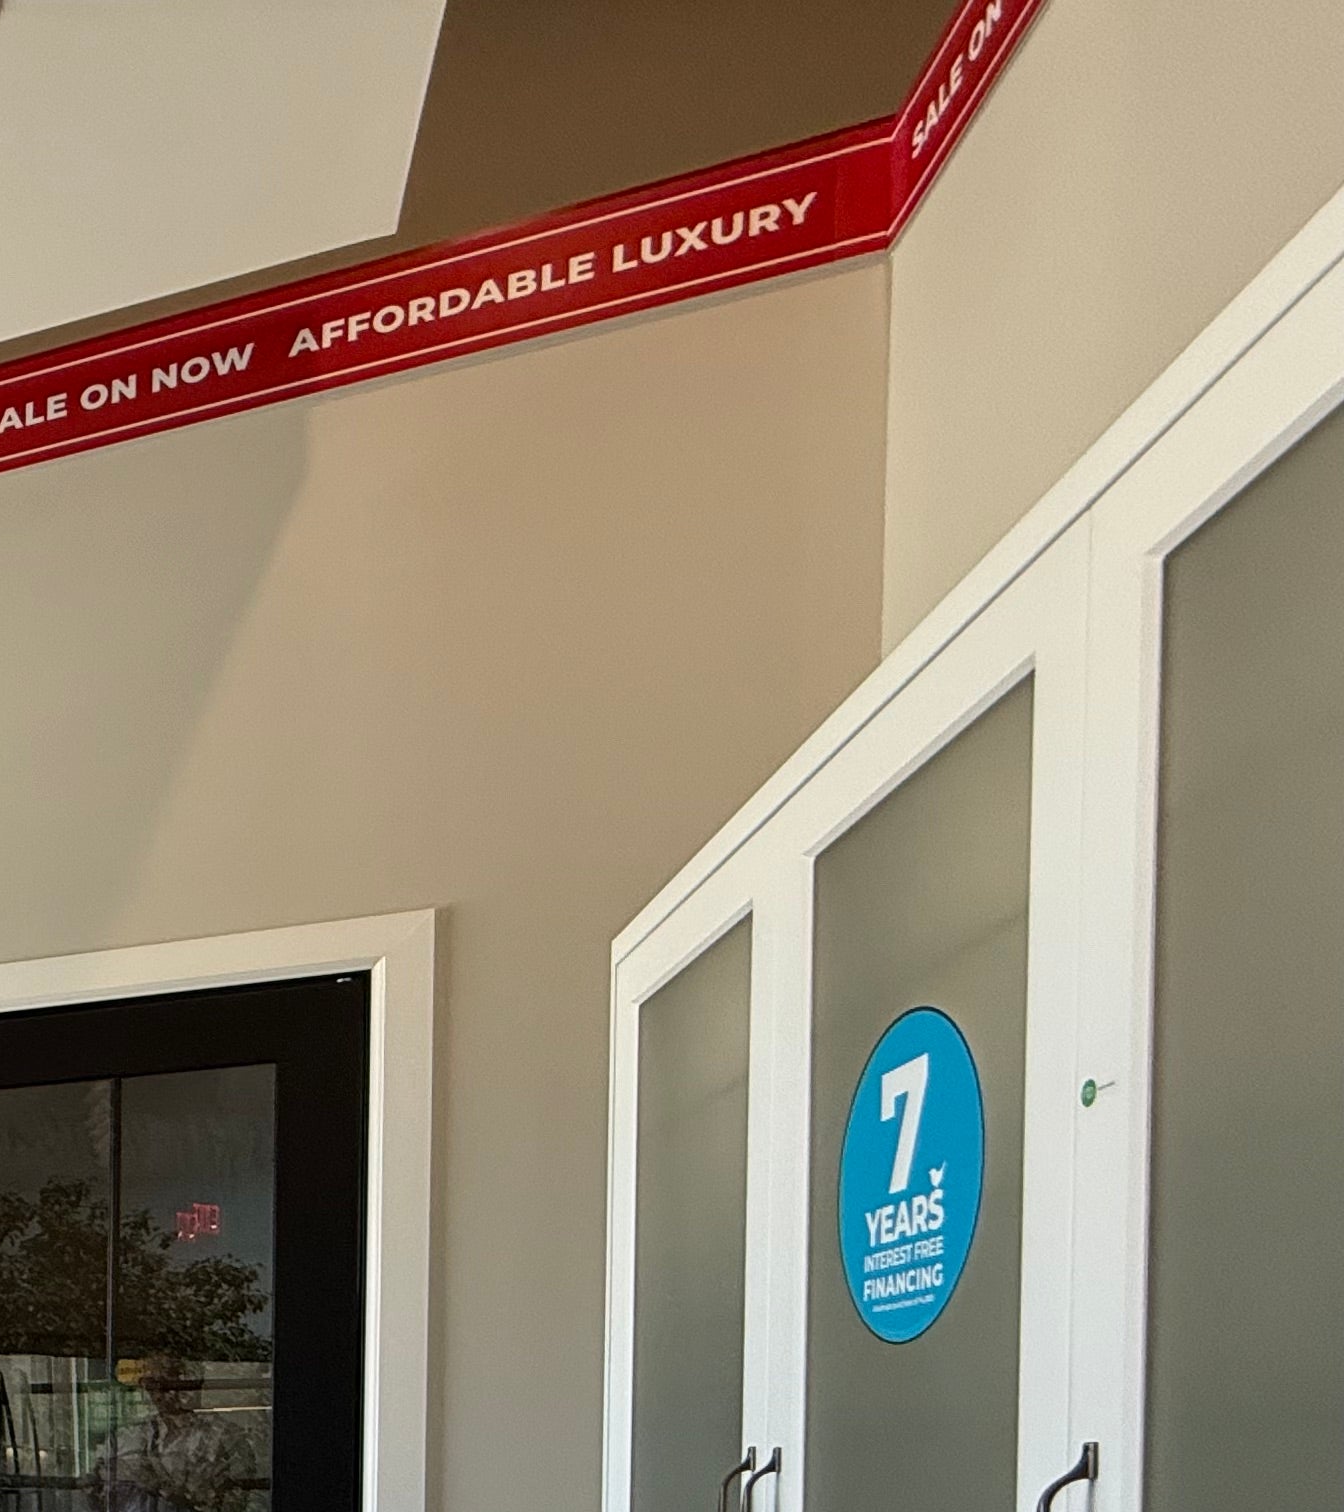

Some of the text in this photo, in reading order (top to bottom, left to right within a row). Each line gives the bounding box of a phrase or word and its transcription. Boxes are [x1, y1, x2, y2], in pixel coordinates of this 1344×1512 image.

[911, 0, 1002, 159] SALE ON
[80, 374, 137, 410] ON
[151, 342, 254, 393] NOW
[288, 251, 595, 358] AFFORDABLE
[612, 191, 817, 273] LUXURY
[879, 1052, 929, 1195] 7
[863, 1234, 945, 1274] INTEREST FREE
[864, 1188, 945, 1248] YEARS
[862, 1262, 945, 1302] FINANCING
